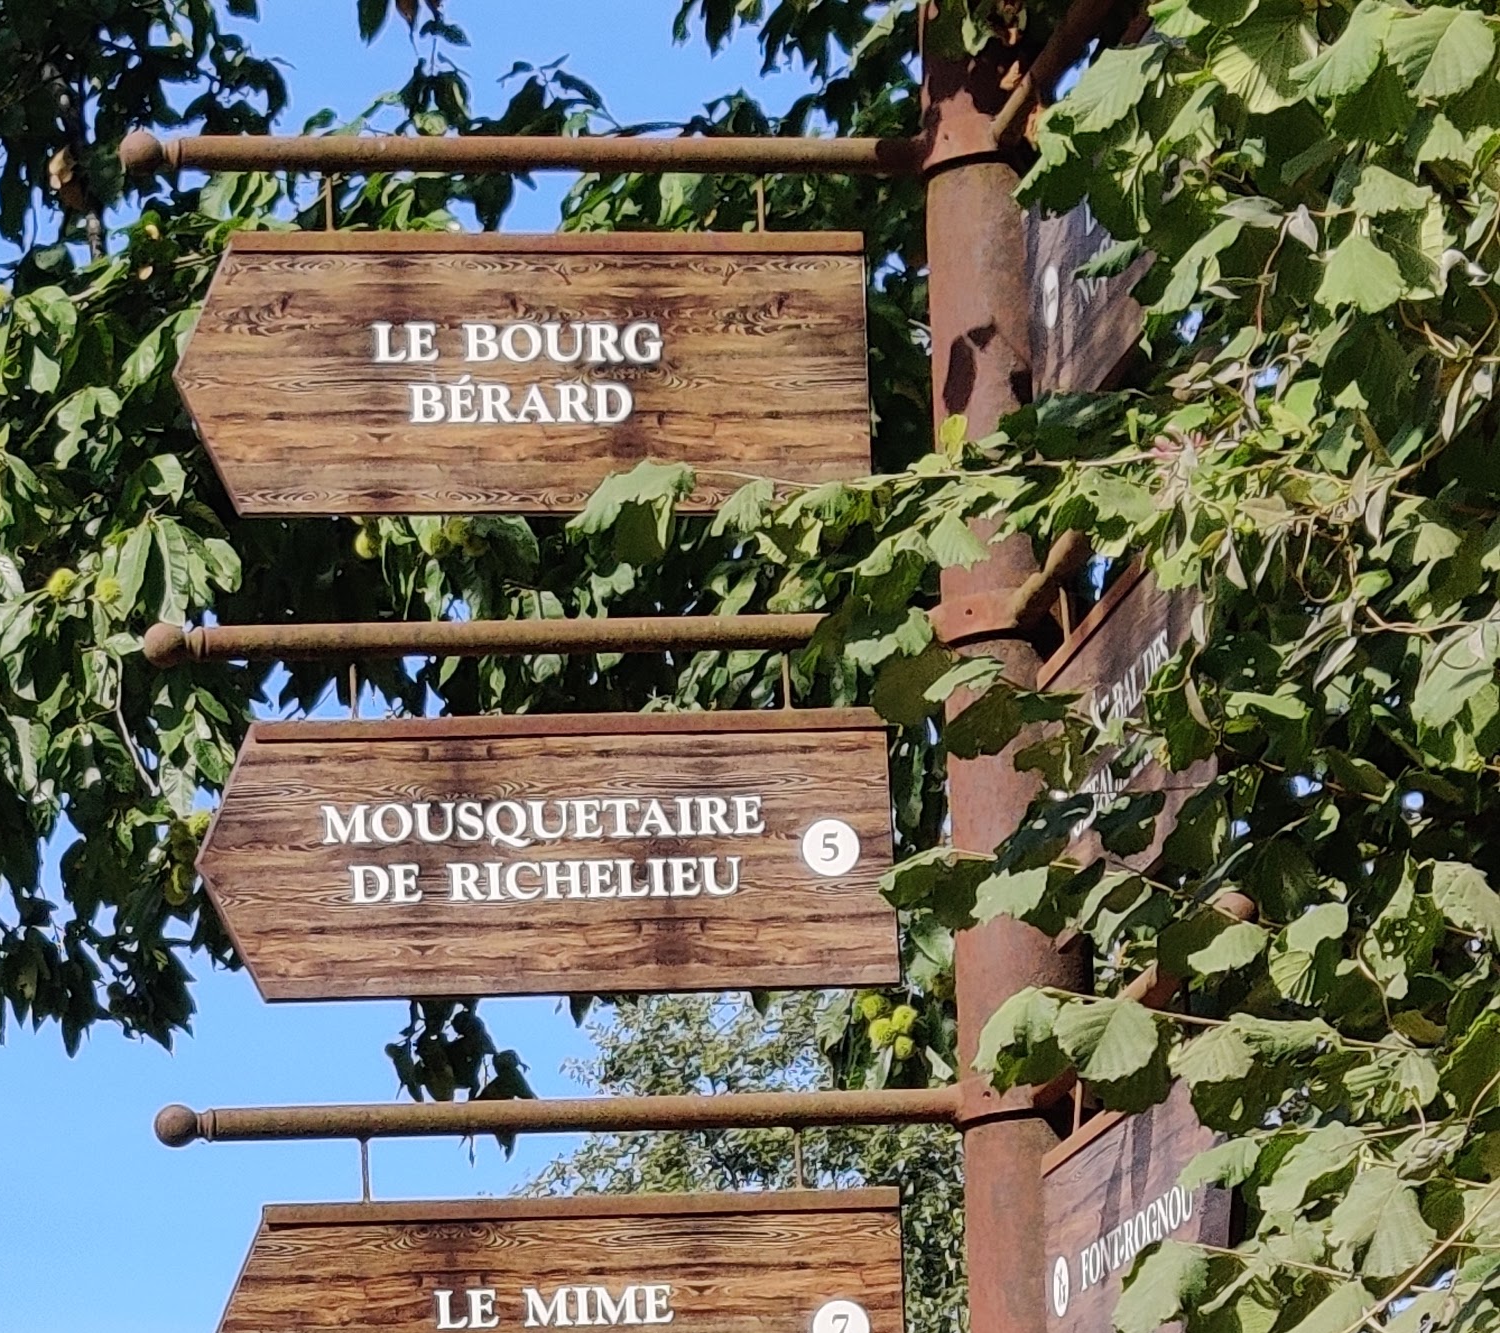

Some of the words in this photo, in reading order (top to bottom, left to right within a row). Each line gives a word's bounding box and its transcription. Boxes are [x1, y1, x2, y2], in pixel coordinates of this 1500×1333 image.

[372, 323, 439, 363] LE
[462, 323, 663, 362] BOURG
[407, 374, 633, 423] BÉRARD
[320, 796, 765, 848] MOUSQUETAIRE
[819, 831, 840, 862] 5
[348, 864, 423, 904] DE
[446, 856, 741, 901] RICHELIEU
[434, 1289, 499, 1329] LE
[522, 1284, 674, 1327] MIME
